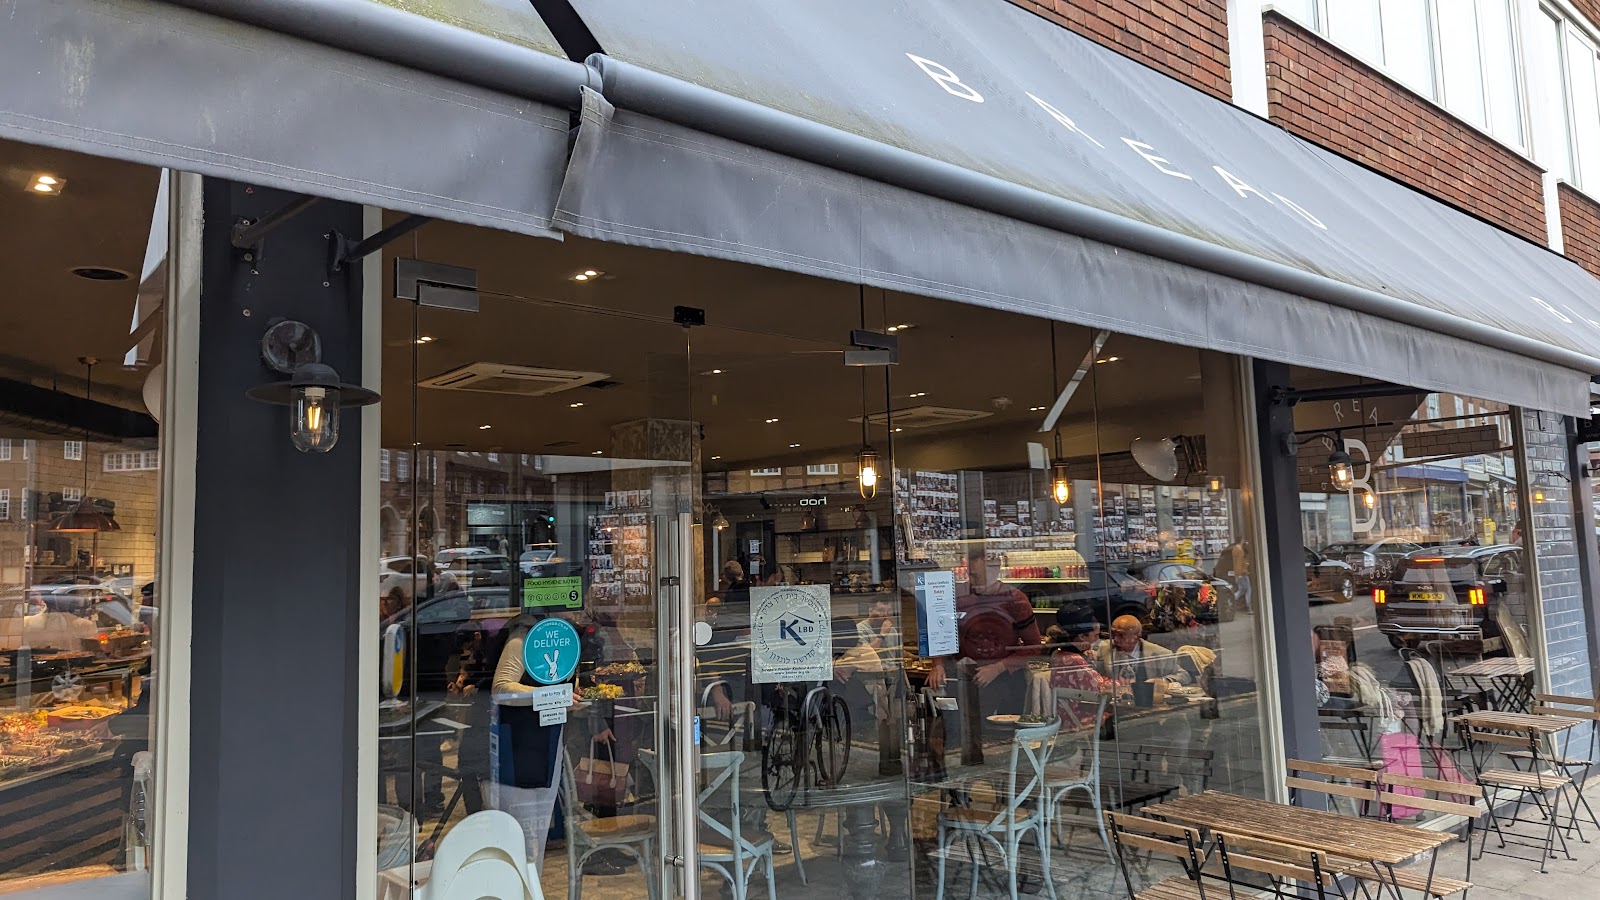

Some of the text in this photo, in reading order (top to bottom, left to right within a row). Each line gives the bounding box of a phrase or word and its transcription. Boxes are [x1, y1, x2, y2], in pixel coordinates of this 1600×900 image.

[906, 53, 1328, 230] BREAD
[571, 591, 577, 600] 5
[545, 630, 559, 639] WE
[533, 638, 570, 648] DELIVER
